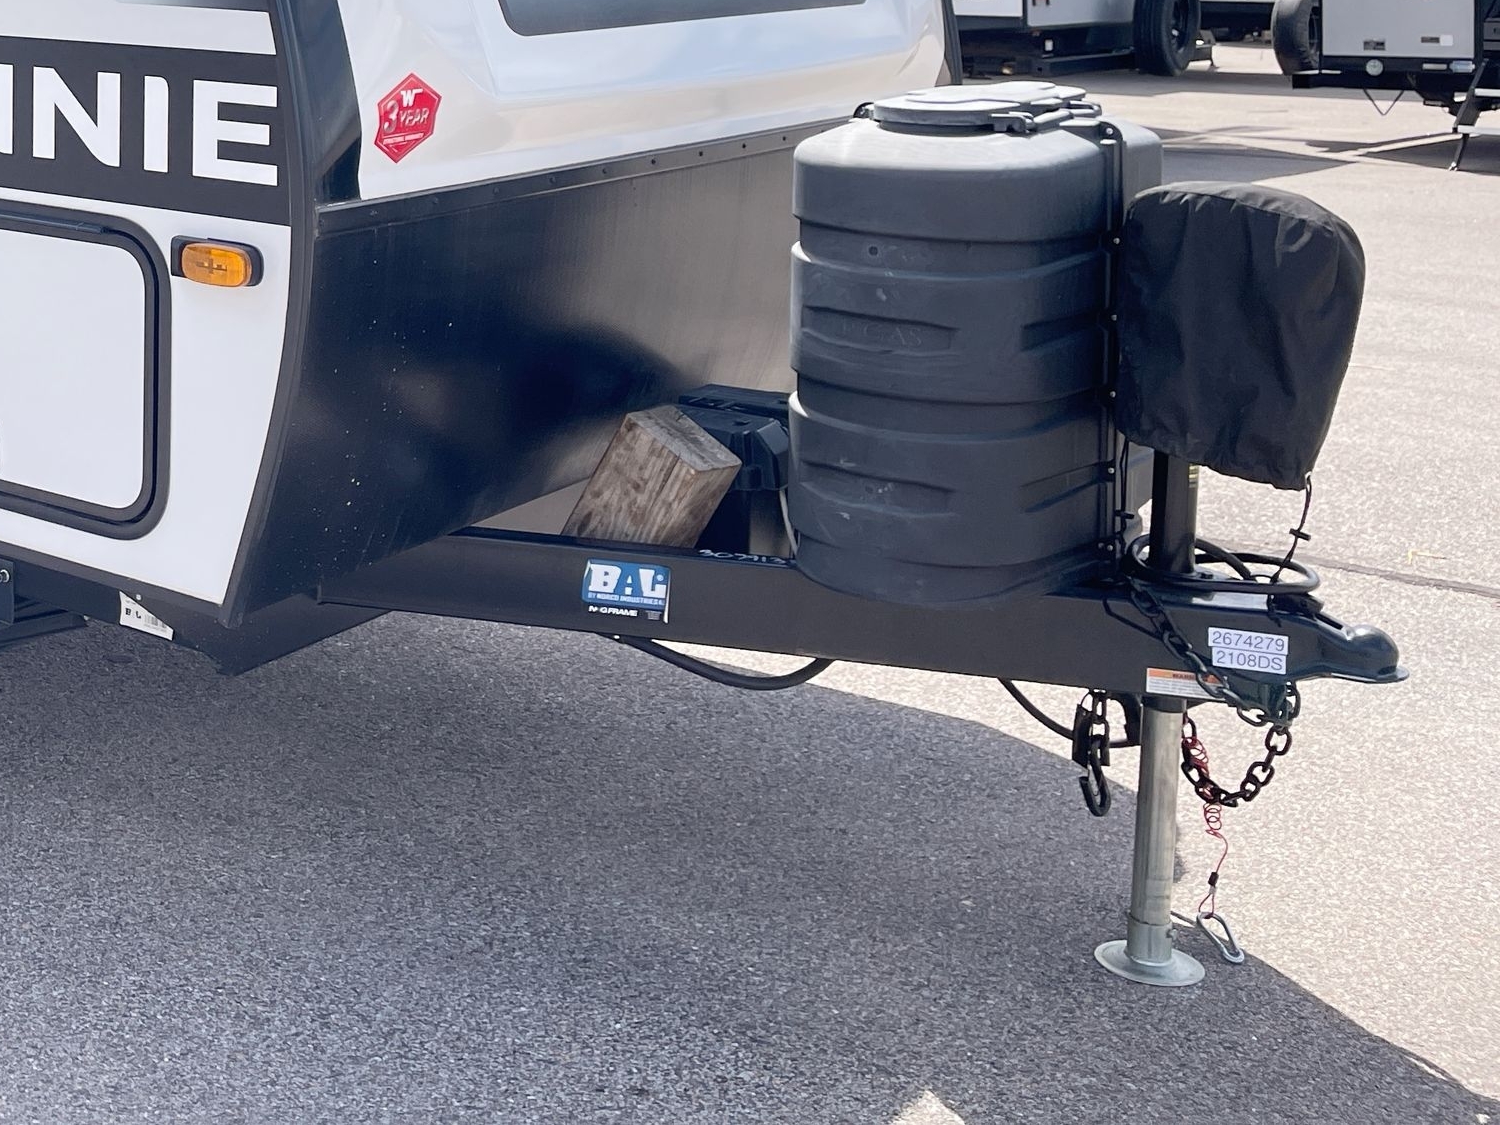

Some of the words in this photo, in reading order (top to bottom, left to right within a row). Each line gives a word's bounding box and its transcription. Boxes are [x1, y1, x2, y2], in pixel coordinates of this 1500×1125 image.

[399, 107, 430, 127] YEAR
[1212, 630, 1285, 652] 2674279
[1216, 650, 1283, 671] 2108DS
